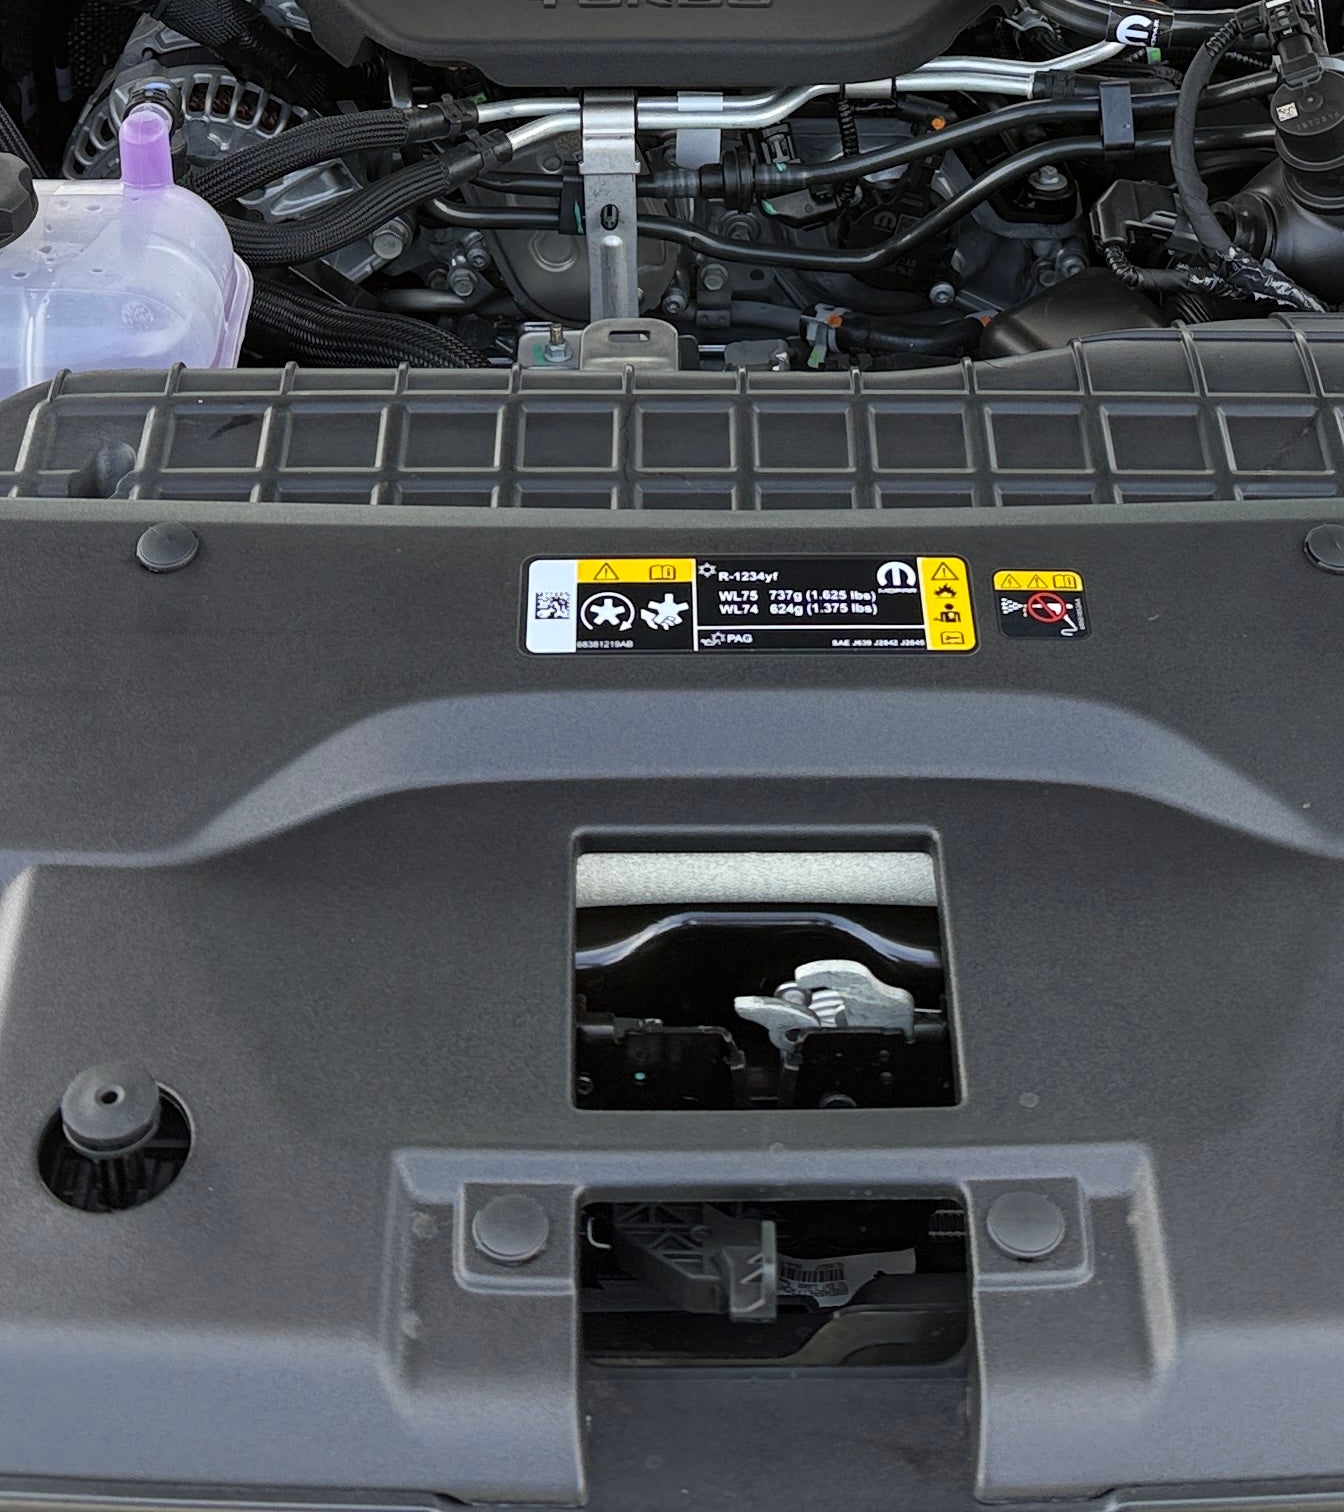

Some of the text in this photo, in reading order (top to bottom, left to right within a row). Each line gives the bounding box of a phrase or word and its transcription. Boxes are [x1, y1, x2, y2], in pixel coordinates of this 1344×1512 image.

[718, 571, 779, 584] R-1234yf
[718, 589, 877, 603] WL75 737g (1.625 lbs)
[719, 602, 879, 616] WL74 624g (1.375 lbs)
[727, 634, 753, 643] PAG
